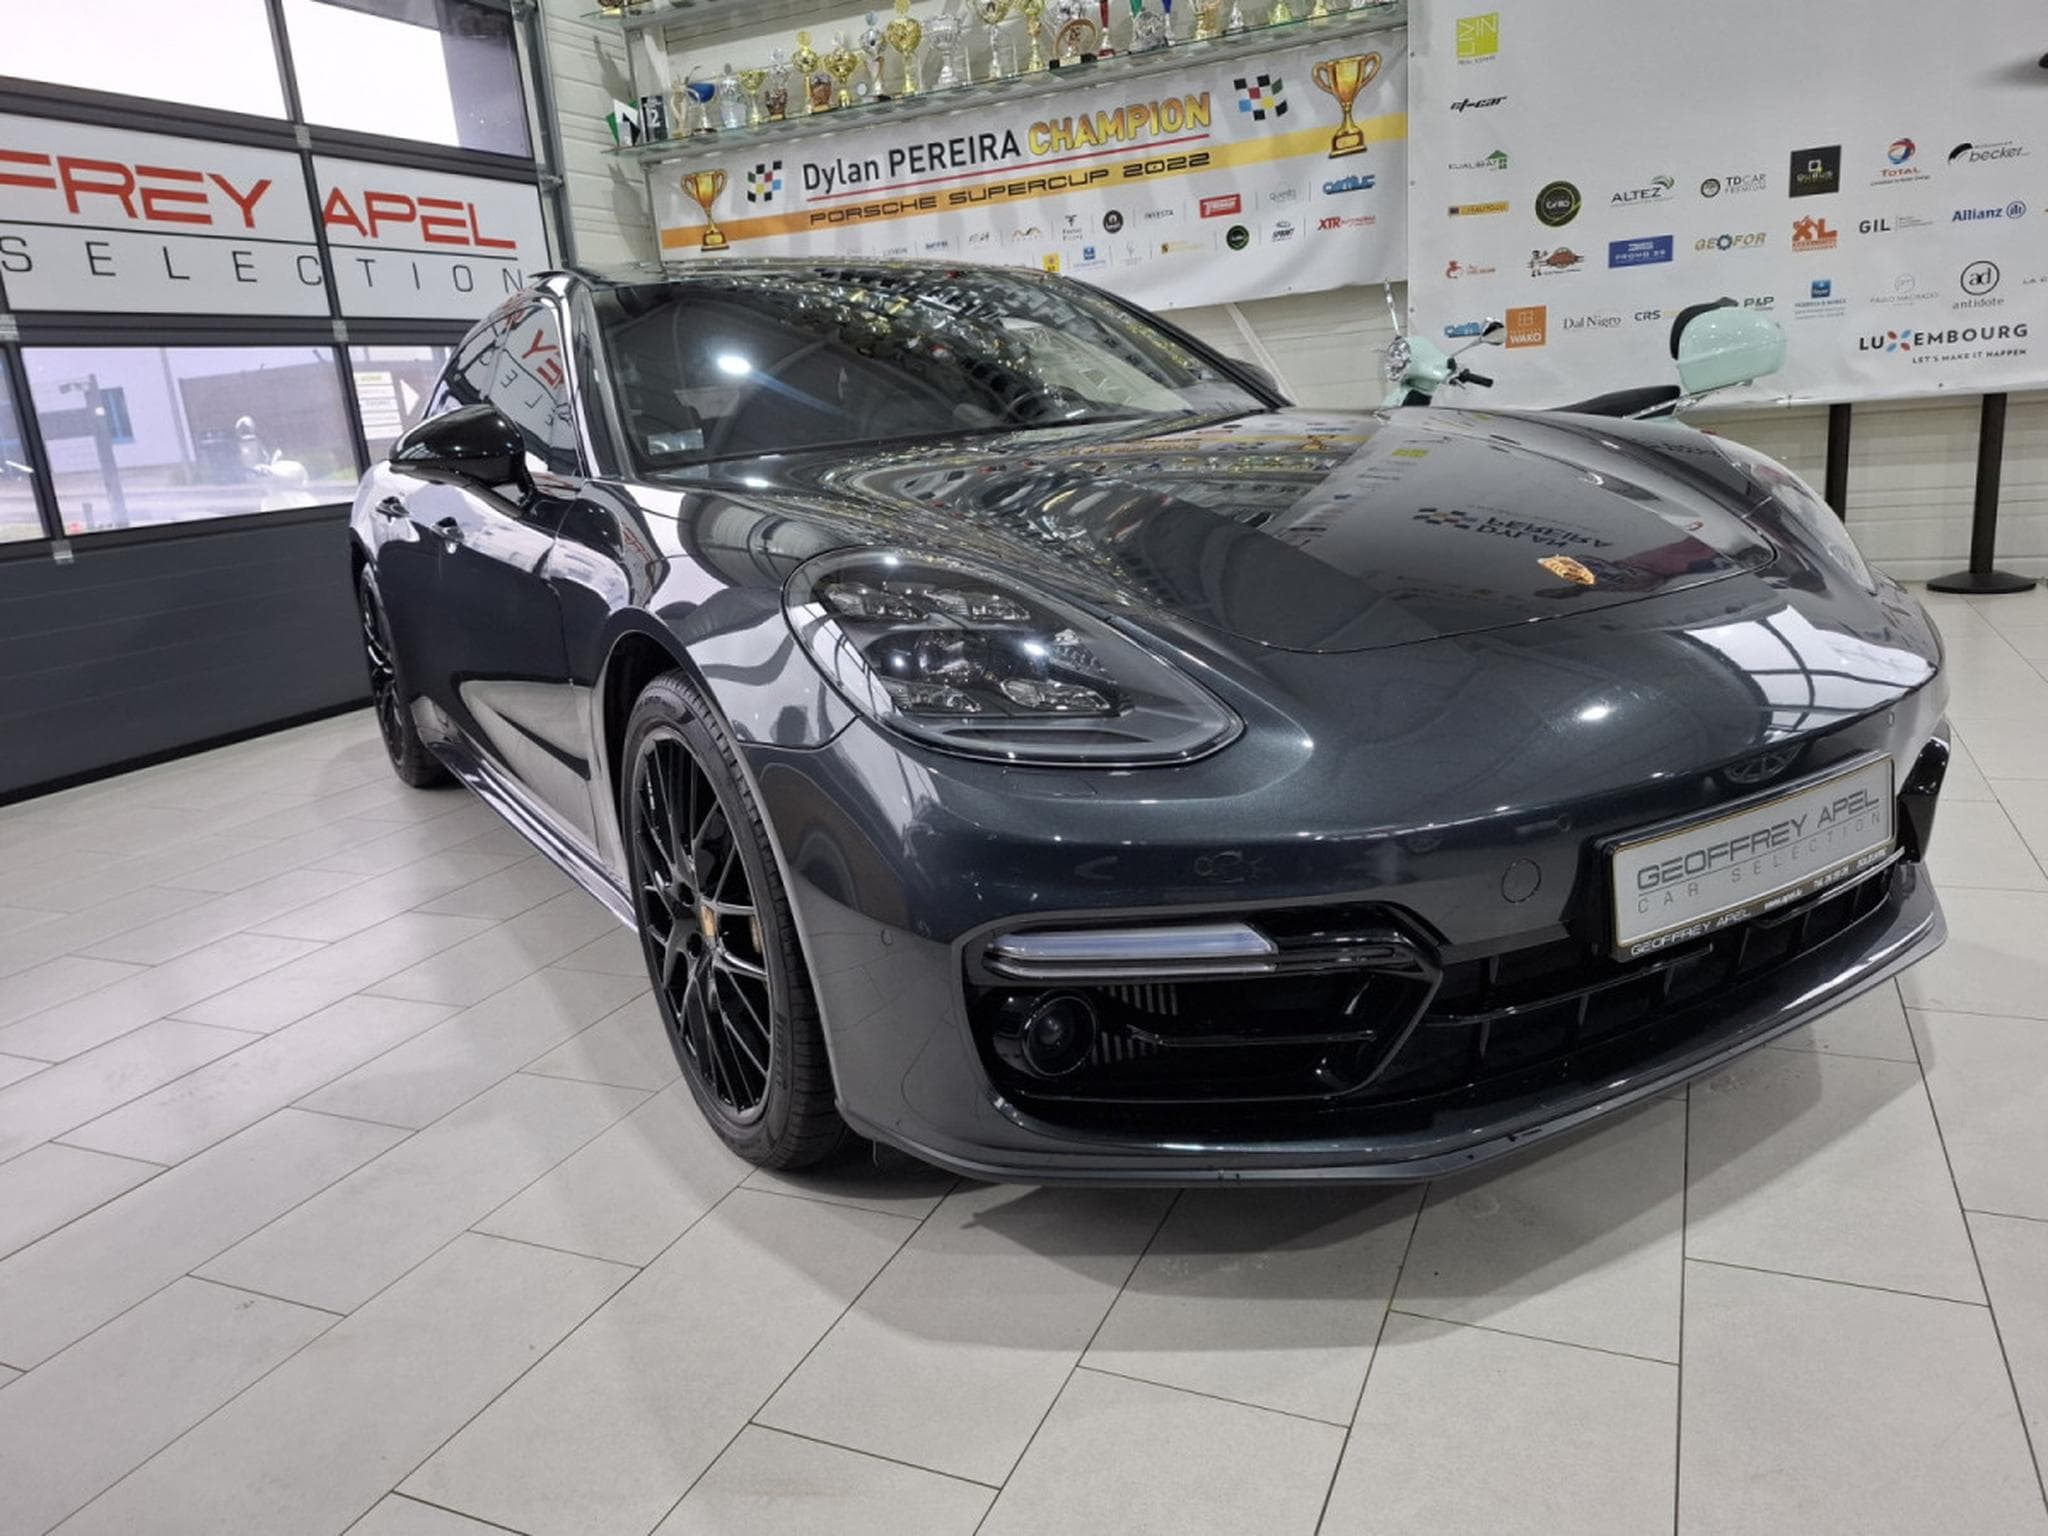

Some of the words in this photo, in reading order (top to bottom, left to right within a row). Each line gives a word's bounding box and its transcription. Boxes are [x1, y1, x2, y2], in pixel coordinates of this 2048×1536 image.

[803, 157, 880, 195] Dylan
[888, 130, 1021, 178] PEREIRA
[1028, 92, 1210, 156] CHAMPION
[1969, 146, 2023, 163] becker
[1881, 166, 1920, 177] TOTAL
[810, 196, 938, 226] PORSCHE
[949, 168, 1109, 206] SUPERCUP
[1123, 152, 1210, 179] 2022
[1611, 187, 1662, 203] ALTEZ
[324, 186, 517, 251] APEL
[1952, 207, 2004, 222] Allianz
[1859, 218, 1891, 234] GIL
[0, 235, 525, 293] SELECTION
[1952, 297, 2005, 310] antidote
[1634, 309, 1661, 322] CRS
[1941, 352, 1970, 361] MAKE
[1986, 348, 2027, 358] HAPPEN
[1637, 814, 1808, 890] GEOFFREY
[1817, 788, 1880, 828] APEL
[1638, 883, 1699, 914] CAR
[1731, 813, 1881, 883] SELECTION
